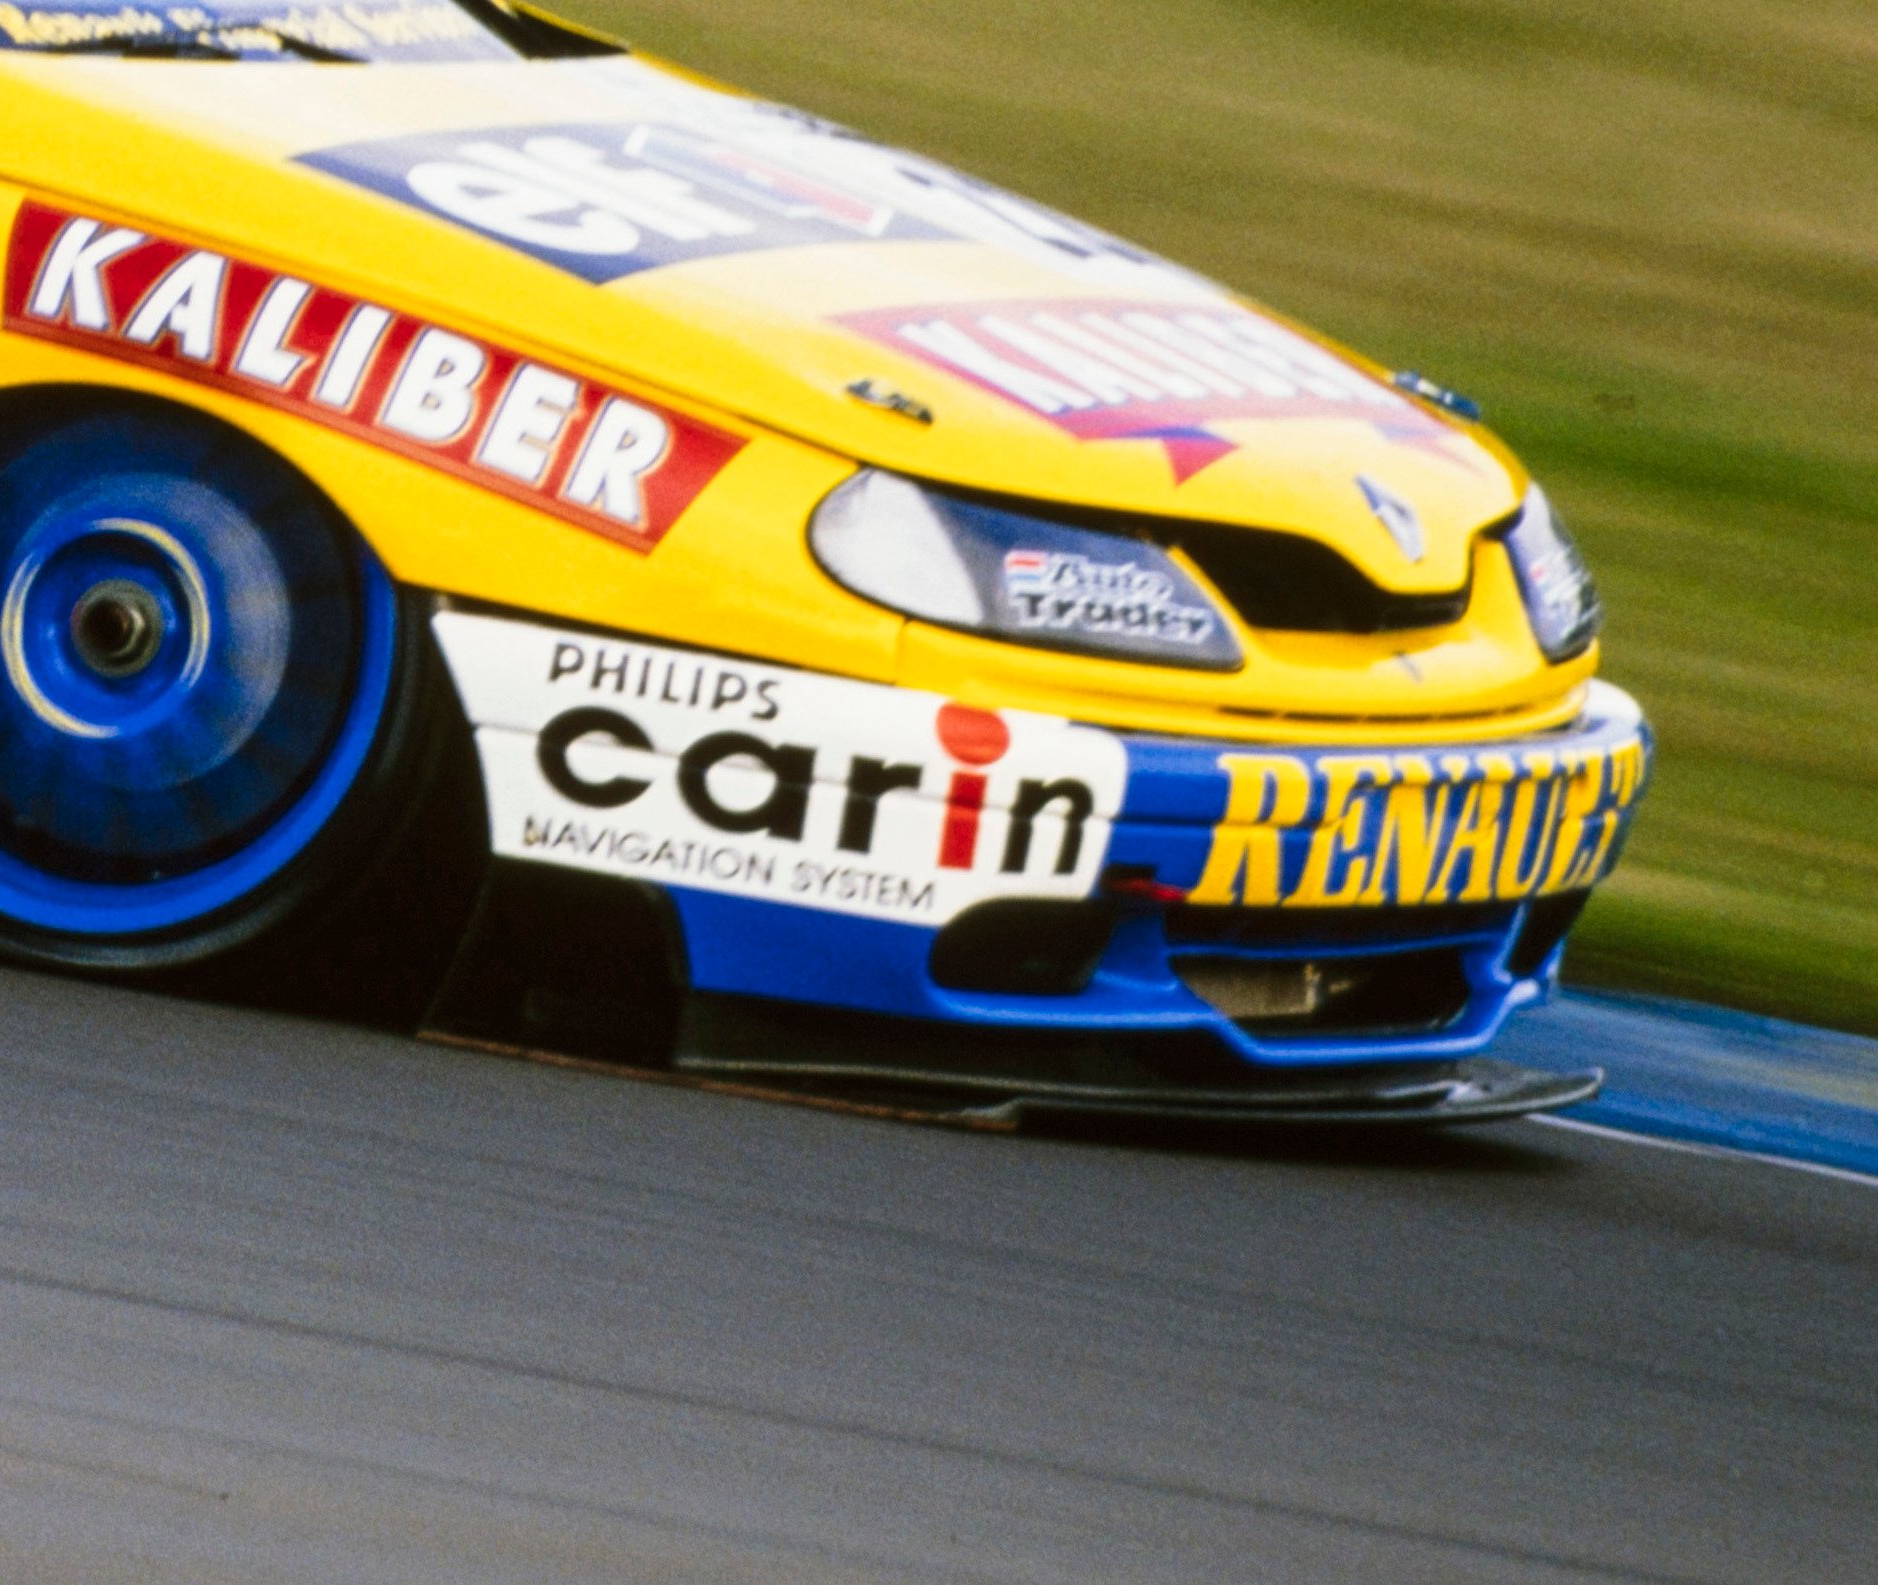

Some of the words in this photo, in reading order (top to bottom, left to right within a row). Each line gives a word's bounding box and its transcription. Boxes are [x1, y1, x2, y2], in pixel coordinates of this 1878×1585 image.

[404, 133, 760, 260] elf
[25, 215, 674, 529] KALIBER
[547, 640, 783, 721] PHILIPS
[535, 700, 1098, 876] carin
[1186, 742, 1645, 907] RENAULT
[521, 814, 777, 888] NAVIGATION
[787, 858, 937, 914] SYSTEM
